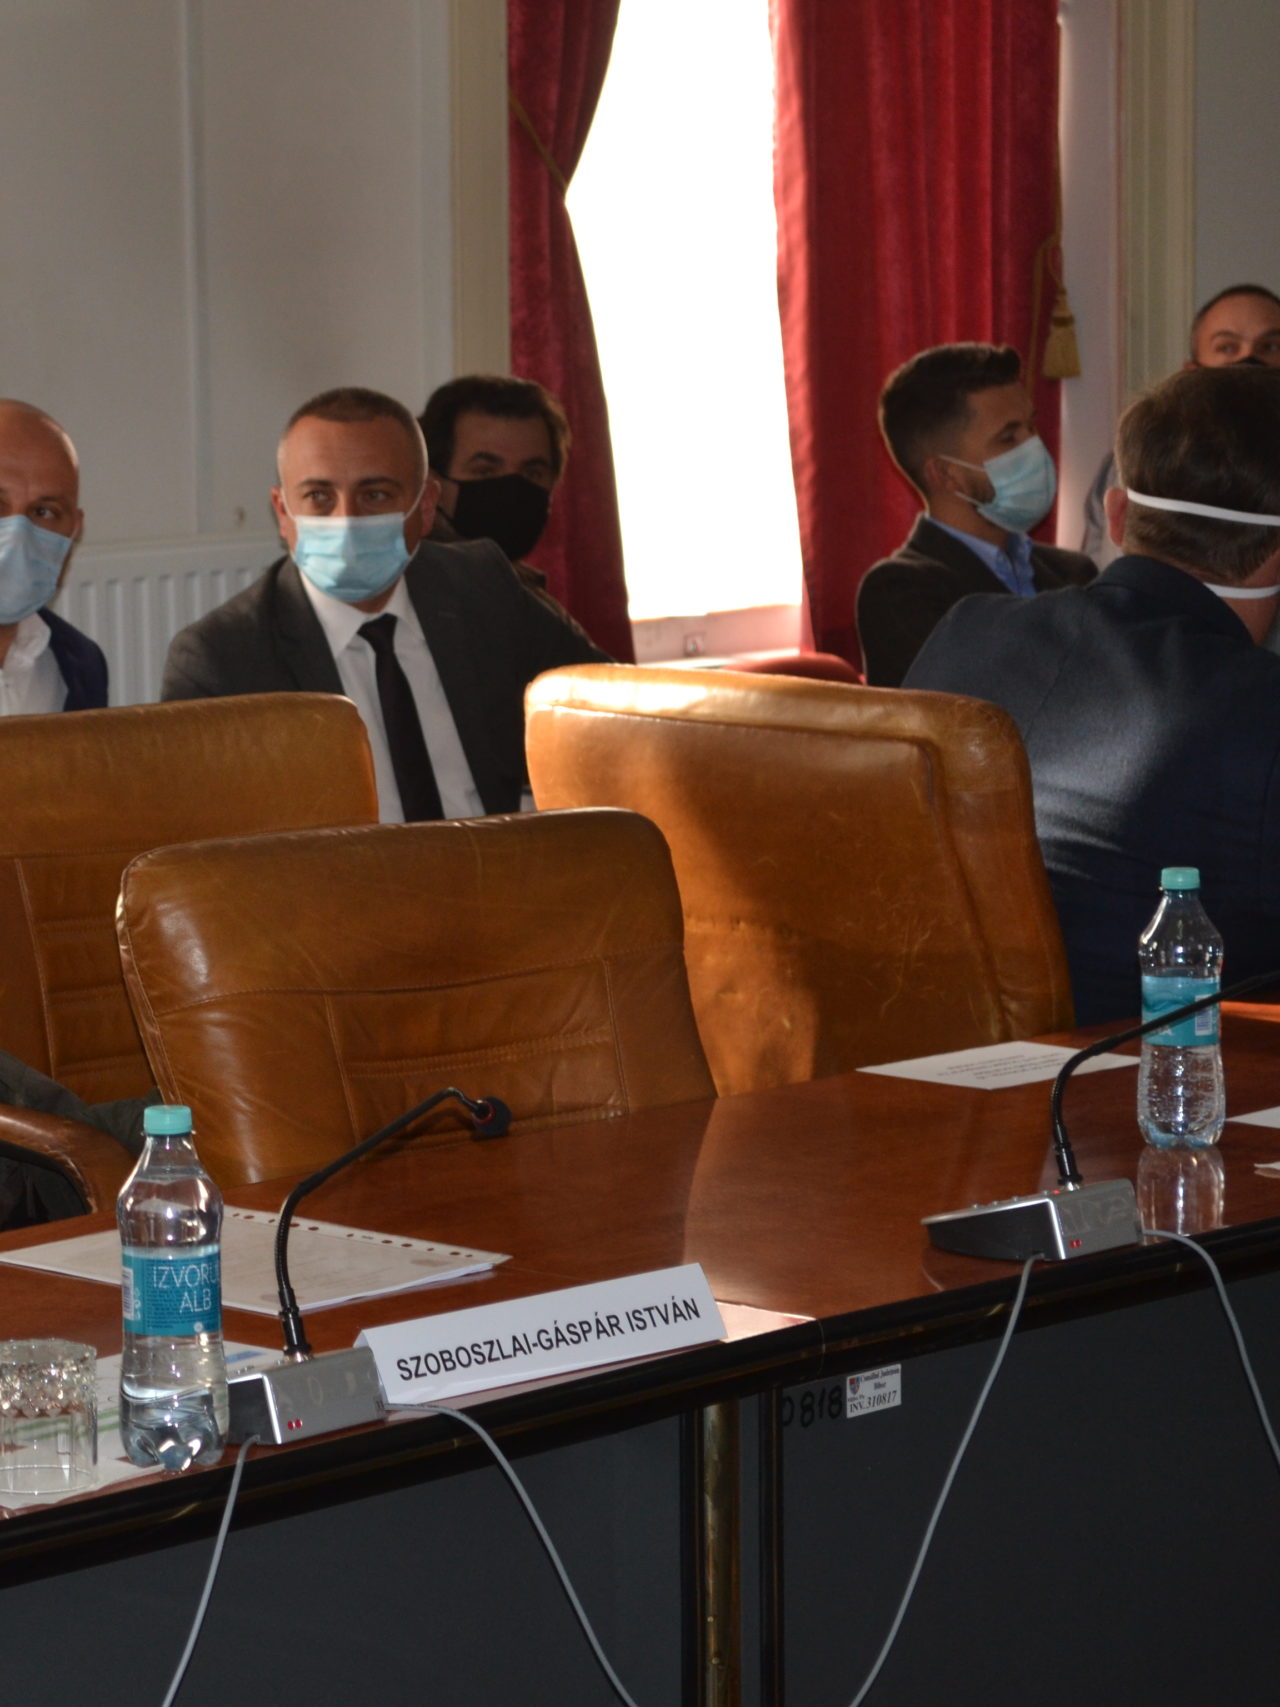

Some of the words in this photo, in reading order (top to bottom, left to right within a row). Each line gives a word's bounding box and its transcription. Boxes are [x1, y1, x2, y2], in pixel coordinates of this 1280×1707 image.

[152, 1263, 219, 1289] IZVORU
[179, 1288, 212, 1314] ALB
[396, 1311, 625, 1381] SZOBOSZLAI-GÁSPÁR
[625, 1295, 701, 1333] ISTVÁN
